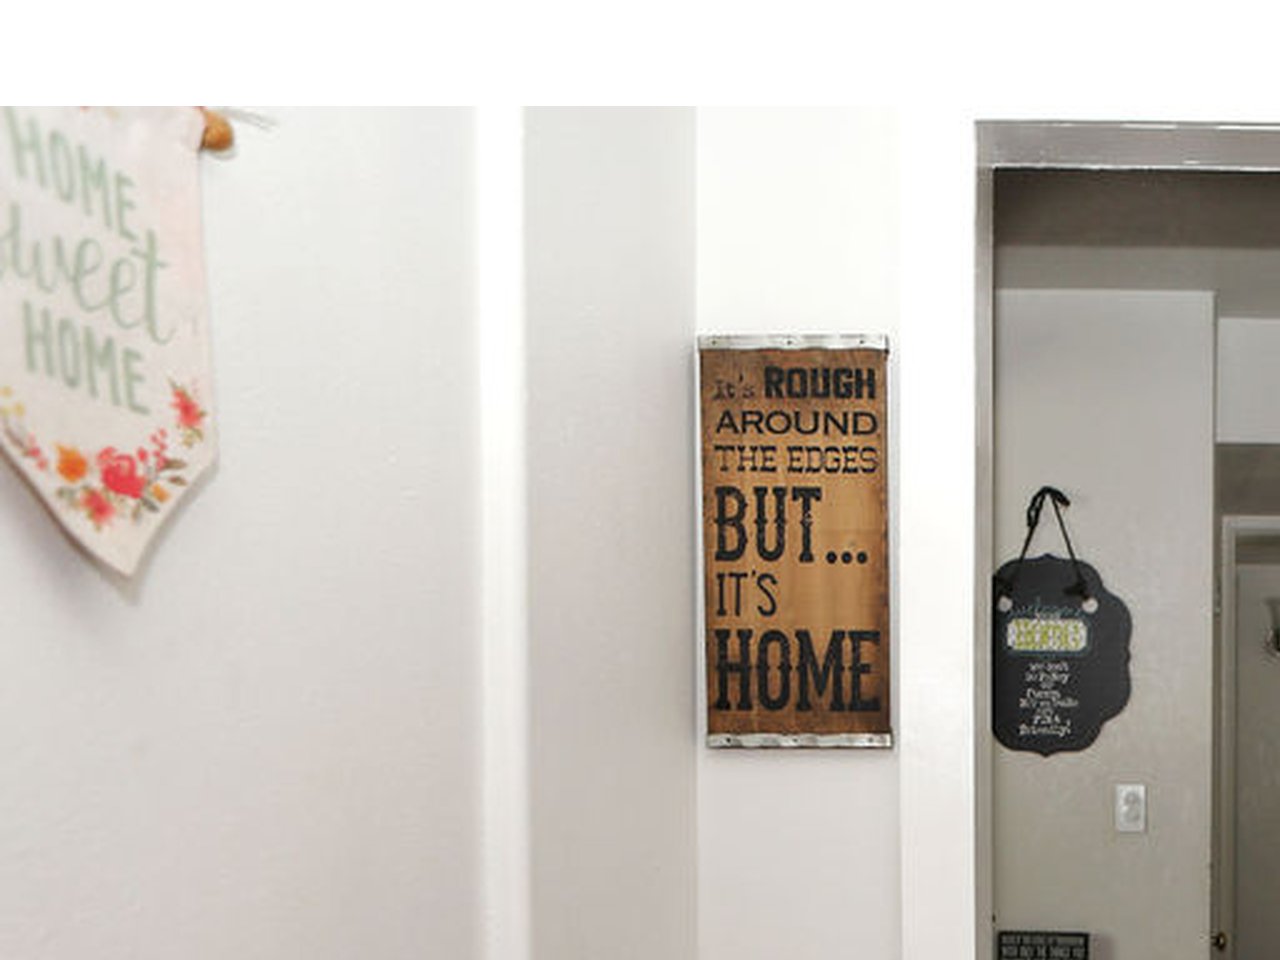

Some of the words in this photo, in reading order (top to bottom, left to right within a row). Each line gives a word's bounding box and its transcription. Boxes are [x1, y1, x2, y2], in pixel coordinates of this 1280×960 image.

[5, 106, 139, 242] HOME
[22, 300, 150, 415] HOME
[763, 365, 876, 400] ROUGH
[715, 410, 879, 436] AROUND
[714, 446, 777, 473] THE
[786, 446, 879, 473] EDGES
[713, 486, 868, 565] BUT...
[716, 569, 779, 617] IT'S
[713, 629, 881, 712] HOME
